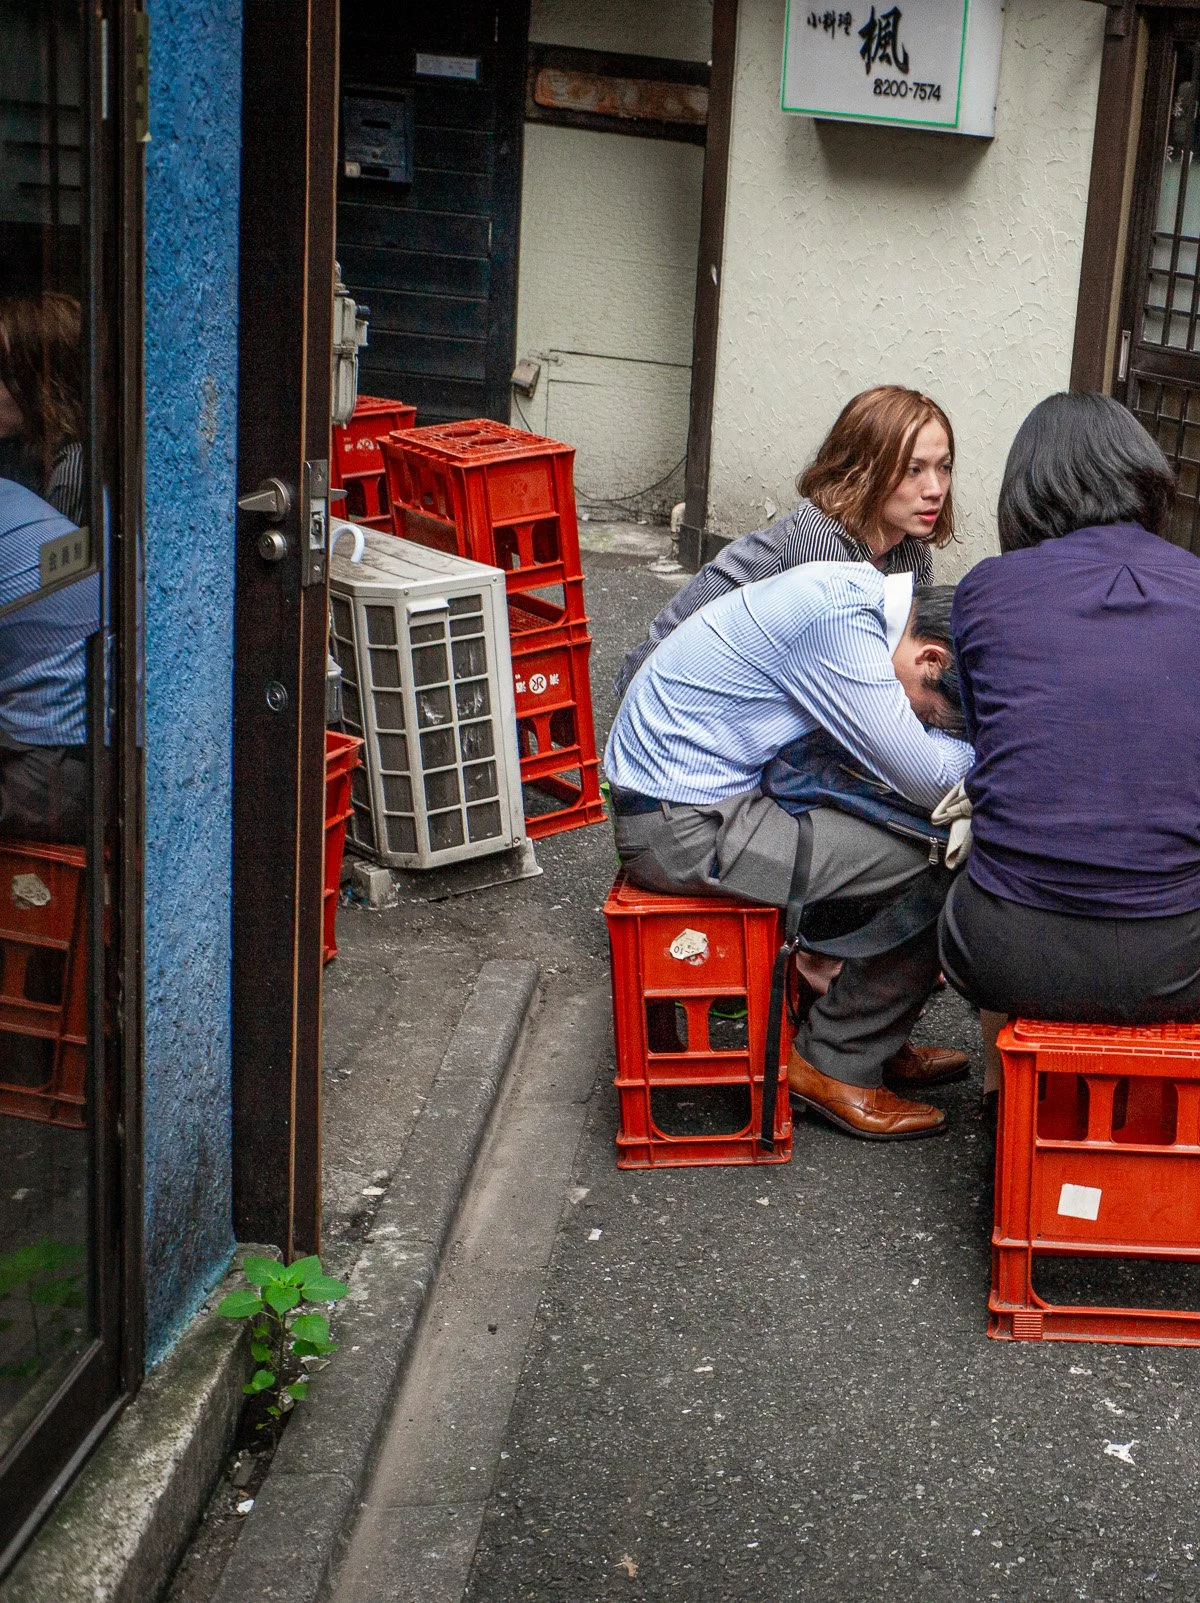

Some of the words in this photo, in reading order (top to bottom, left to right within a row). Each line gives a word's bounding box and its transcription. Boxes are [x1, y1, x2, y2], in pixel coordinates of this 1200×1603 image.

[807, 10, 852, 39] 小料理
[858, 5, 909, 75] 楓
[873, 78, 941, 101] 8200-7574
